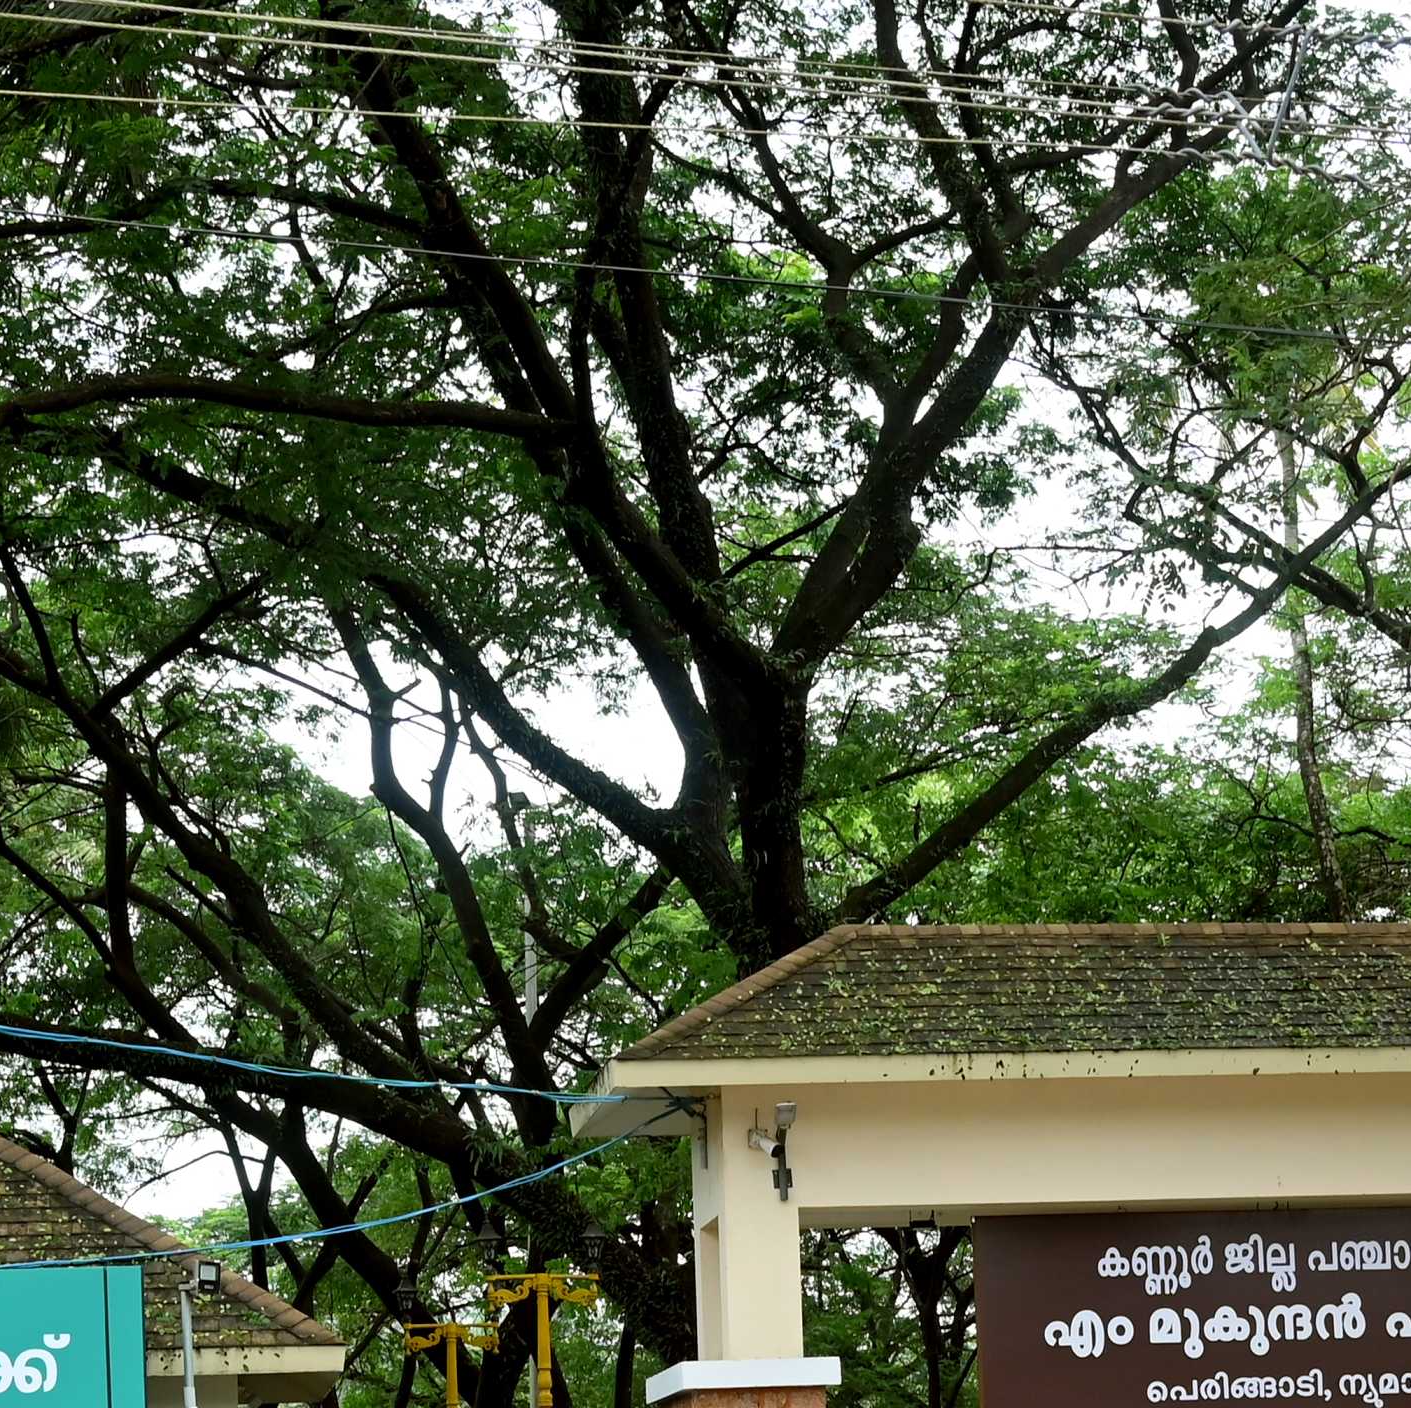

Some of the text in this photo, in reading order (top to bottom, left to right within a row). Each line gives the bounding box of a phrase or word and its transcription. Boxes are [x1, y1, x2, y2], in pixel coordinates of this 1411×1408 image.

[1224, 1233, 1297, 1293] ജില്ല
[1044, 1309, 1135, 1358] എം
[1149, 1292, 1367, 1359] മുകുന്ദൻ
